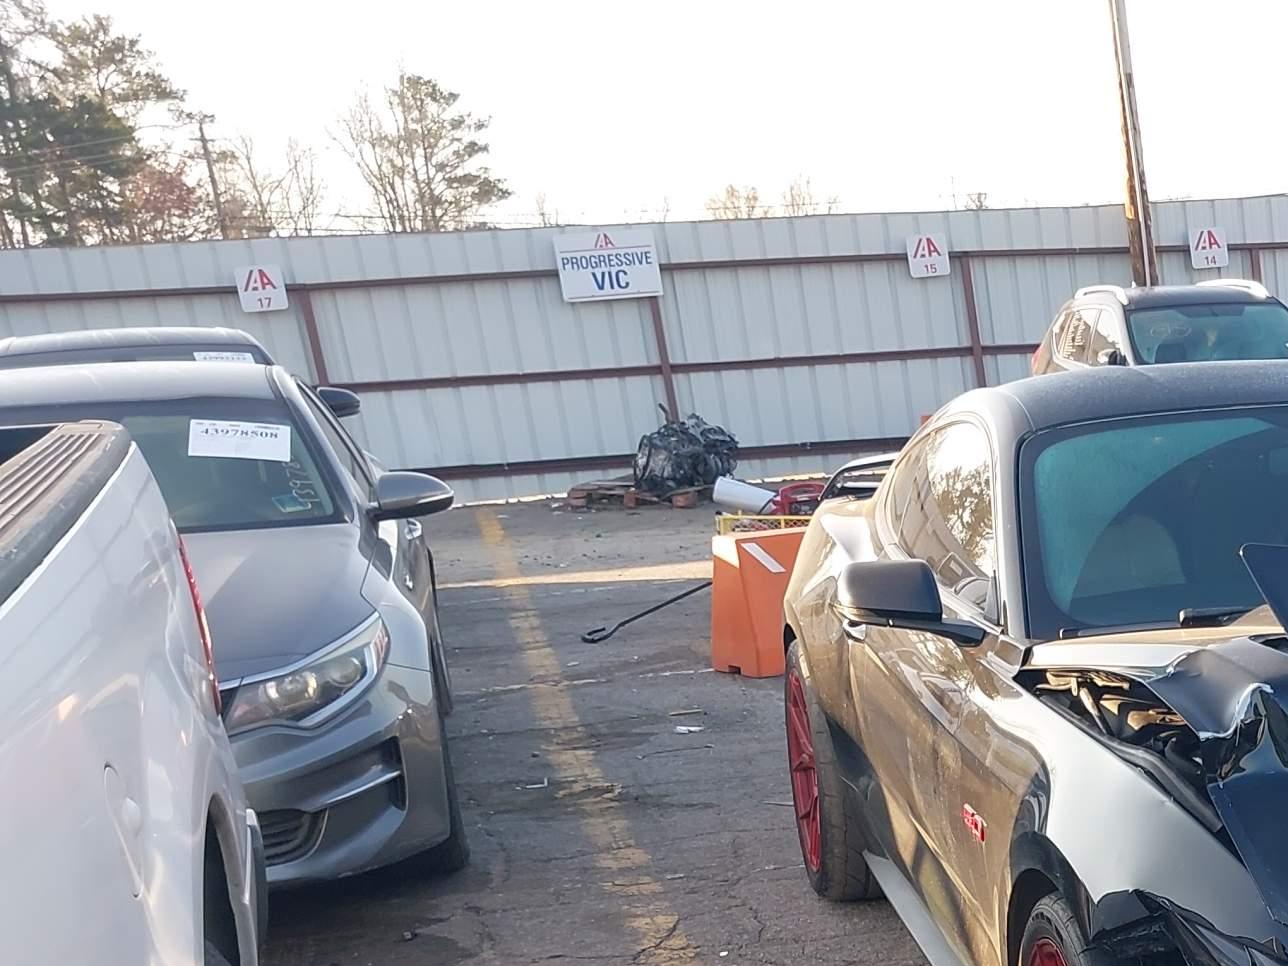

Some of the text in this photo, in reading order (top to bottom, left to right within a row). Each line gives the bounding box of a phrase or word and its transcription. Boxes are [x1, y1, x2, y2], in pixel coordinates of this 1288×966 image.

[561, 250, 653, 271] PROGRESSIVE
[1204, 255, 1217, 266] 14
[923, 262, 938, 274] 15
[591, 269, 631, 291] VIC
[257, 296, 272, 309] 17
[199, 426, 280, 440] 43978508
